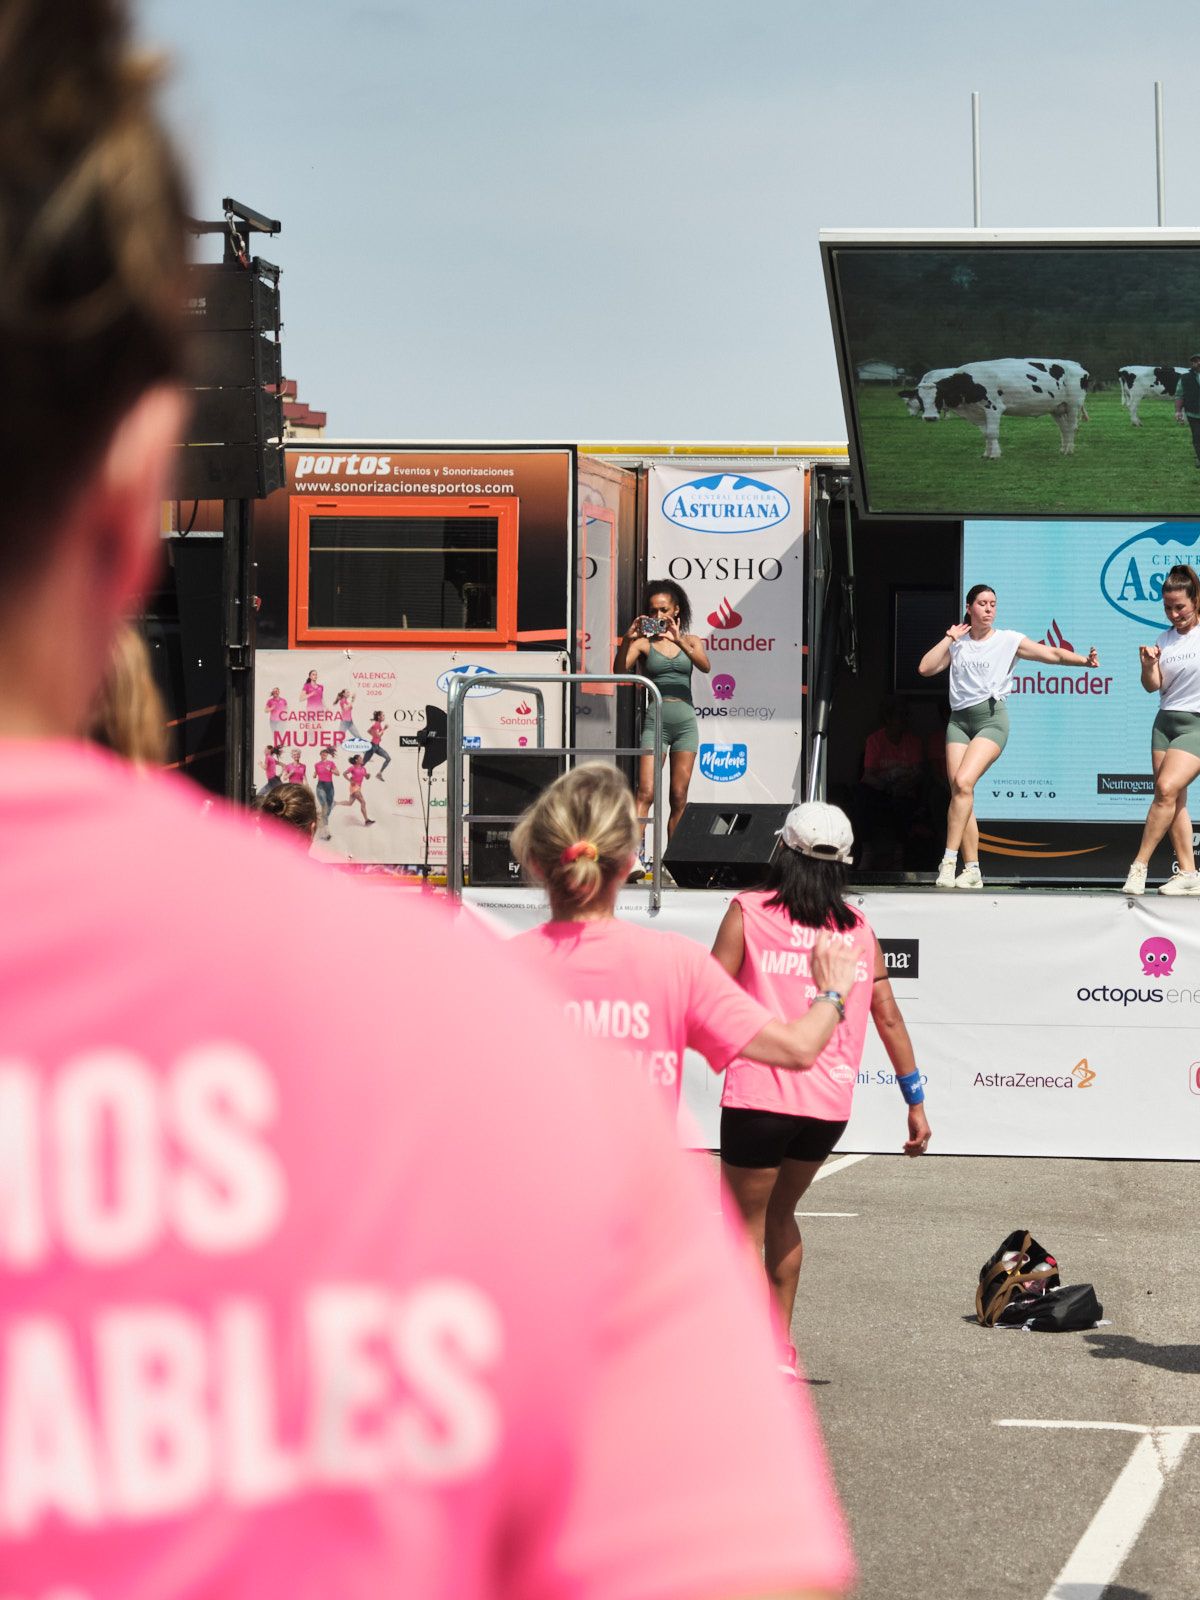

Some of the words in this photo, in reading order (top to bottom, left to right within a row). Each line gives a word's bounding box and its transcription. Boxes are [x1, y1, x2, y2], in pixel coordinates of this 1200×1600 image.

[295, 454, 391, 478] portos
[393, 466, 431, 476] Eventos
[433, 468, 440, 477] y
[442, 466, 514, 476] Sonorizaciones
[294, 481, 514, 495] www.sonorizacionesportos.com
[668, 557, 783, 581] OYSHO
[700, 634, 776, 651] ntander
[1012, 671, 1113, 695] antander
[279, 711, 343, 721] CARRERA
[728, 705, 776, 720] energy
[273, 730, 346, 747] MUJER
[1102, 778, 1154, 793] Neutrogena
[1077, 985, 1164, 1006] octopus
[973, 1072, 1074, 1089] AstraZeneca
